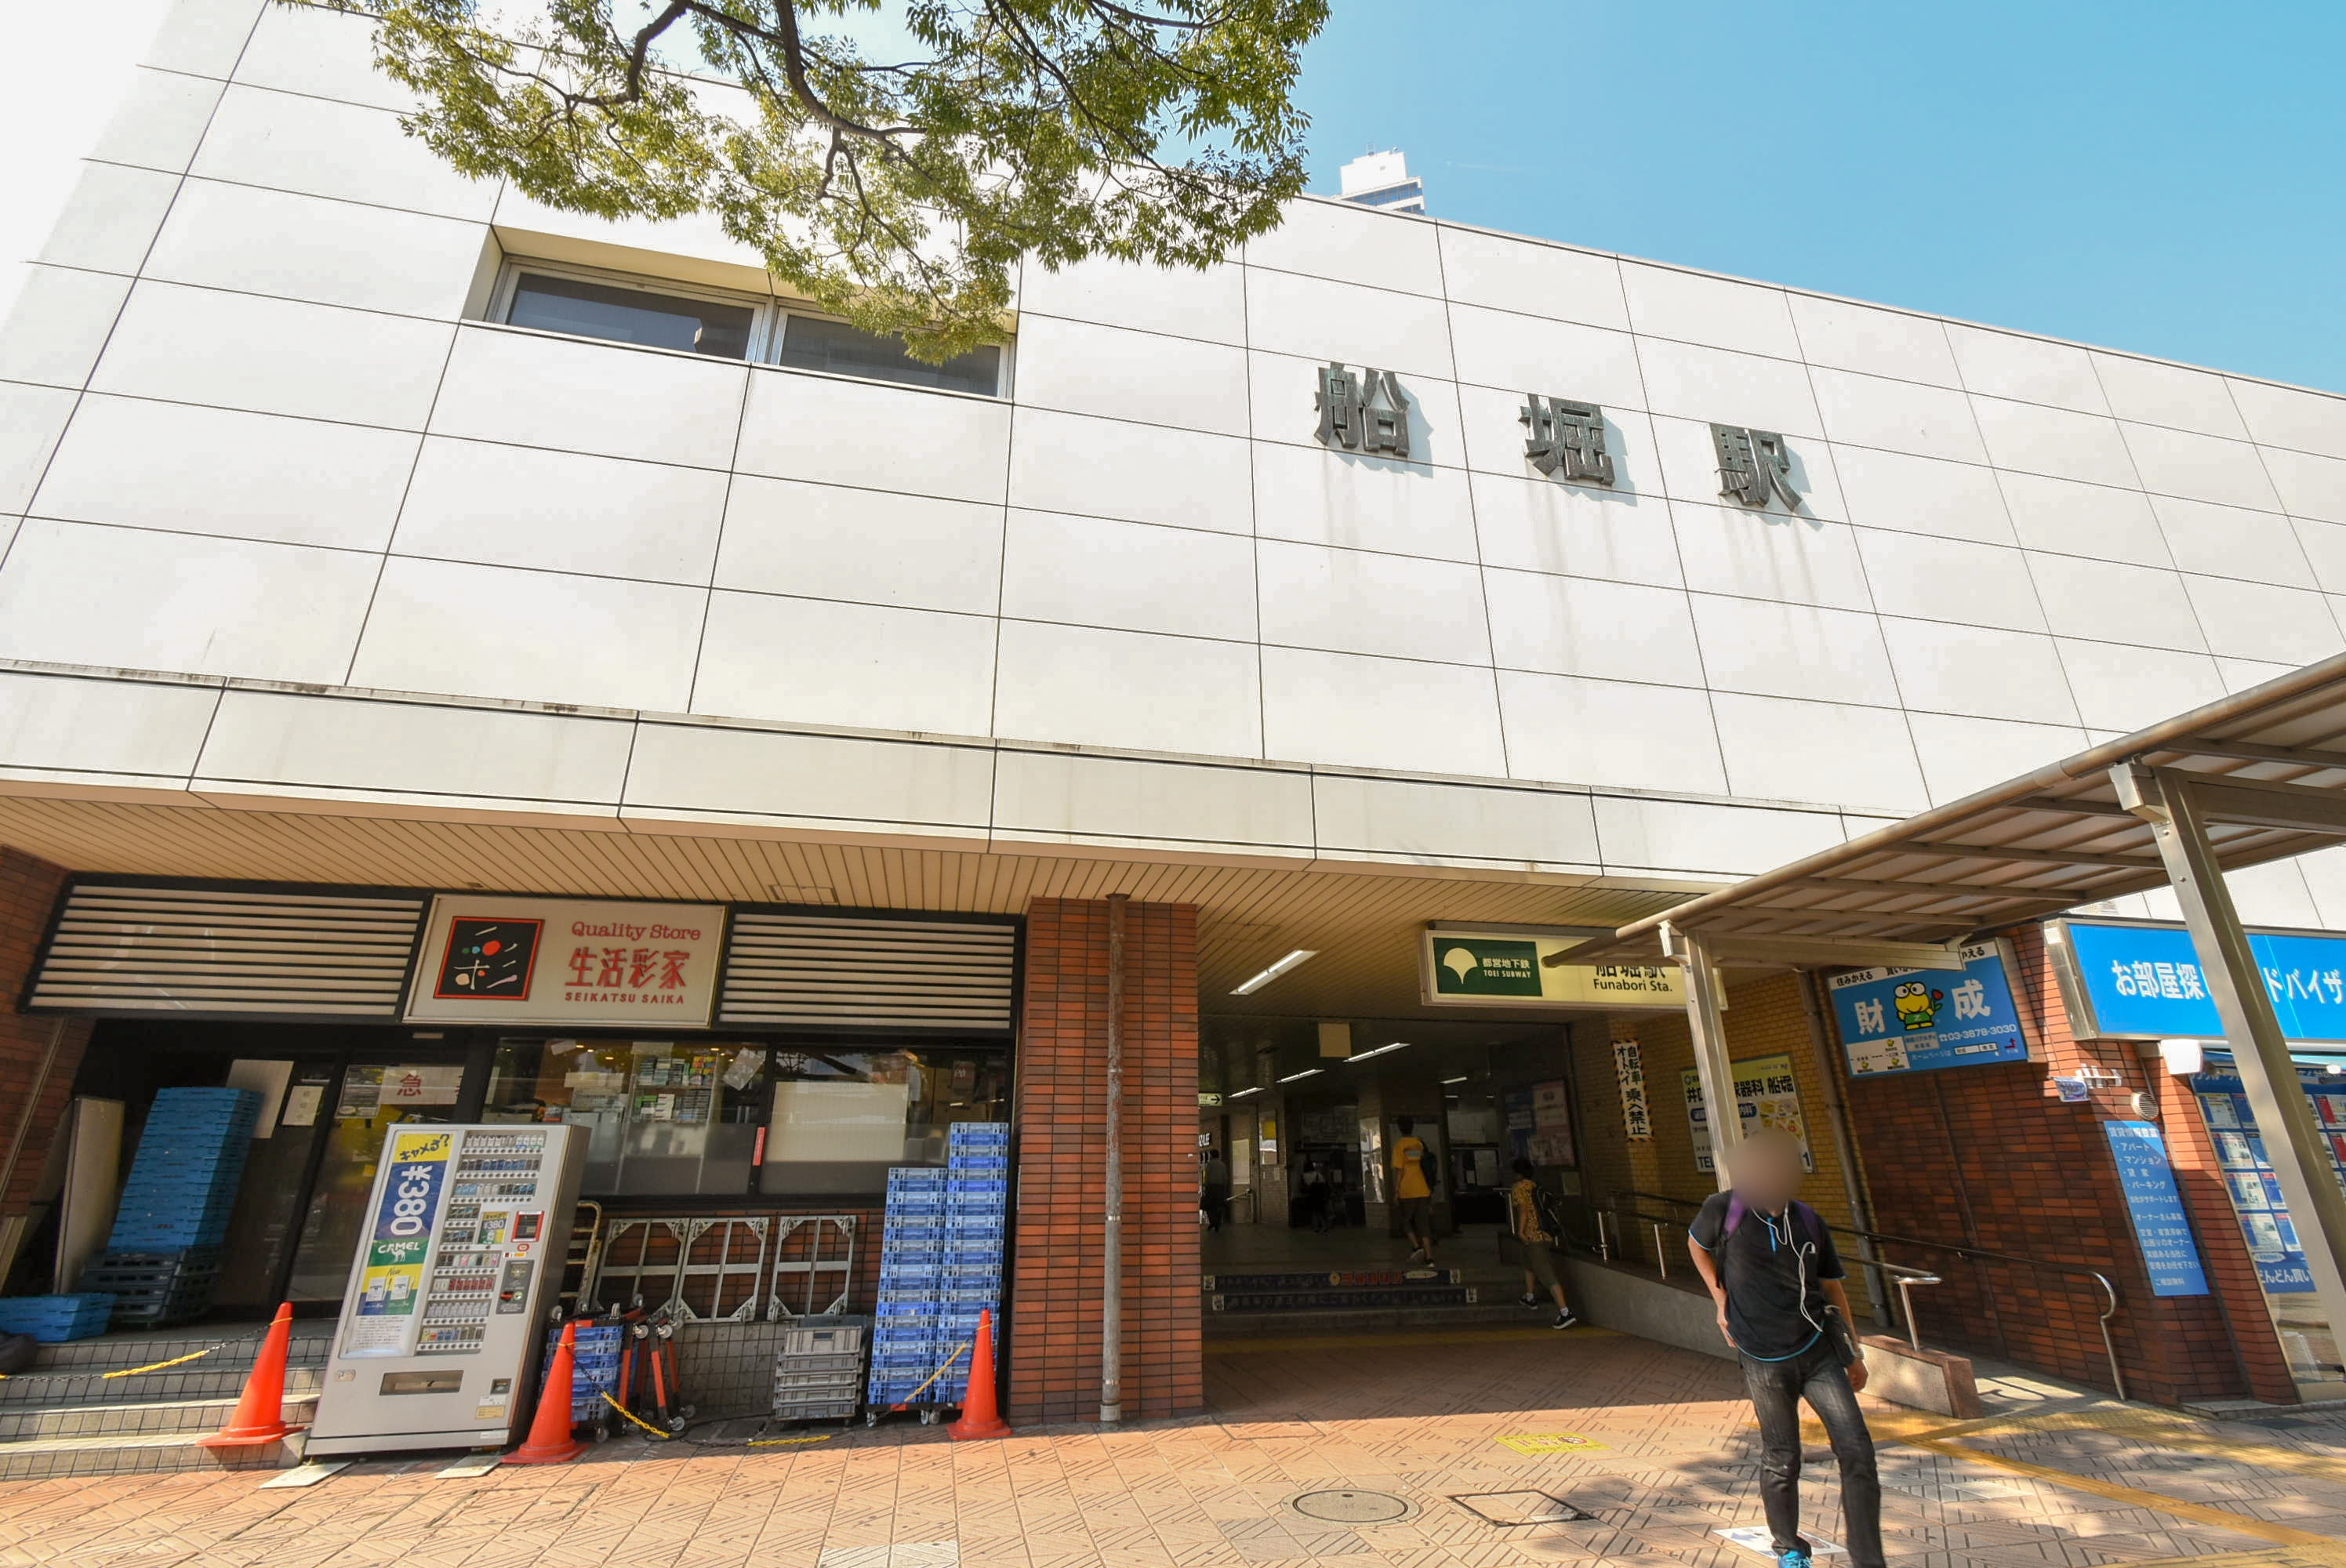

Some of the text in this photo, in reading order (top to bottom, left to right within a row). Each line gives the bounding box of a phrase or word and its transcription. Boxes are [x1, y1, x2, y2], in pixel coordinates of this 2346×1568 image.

[1313, 361, 1803, 512] 船堀駅
[571, 921, 701, 942] Quality Store
[564, 946, 690, 989] 生活彩家
[1482, 957, 1531, 969] 都営地下鉄
[1483, 969, 1531, 978] TOEI SUBWAY
[1592, 978, 1673, 993] Funabori Sta.
[564, 991, 685, 1004] SEIKATSU SAIKA
[1628, 1047, 1641, 1086] 自転車
[1625, 1087, 1648, 1136] 乗入禁止
[390, 1165, 434, 1236] ¥380
[377, 1241, 420, 1254] CAMEL
